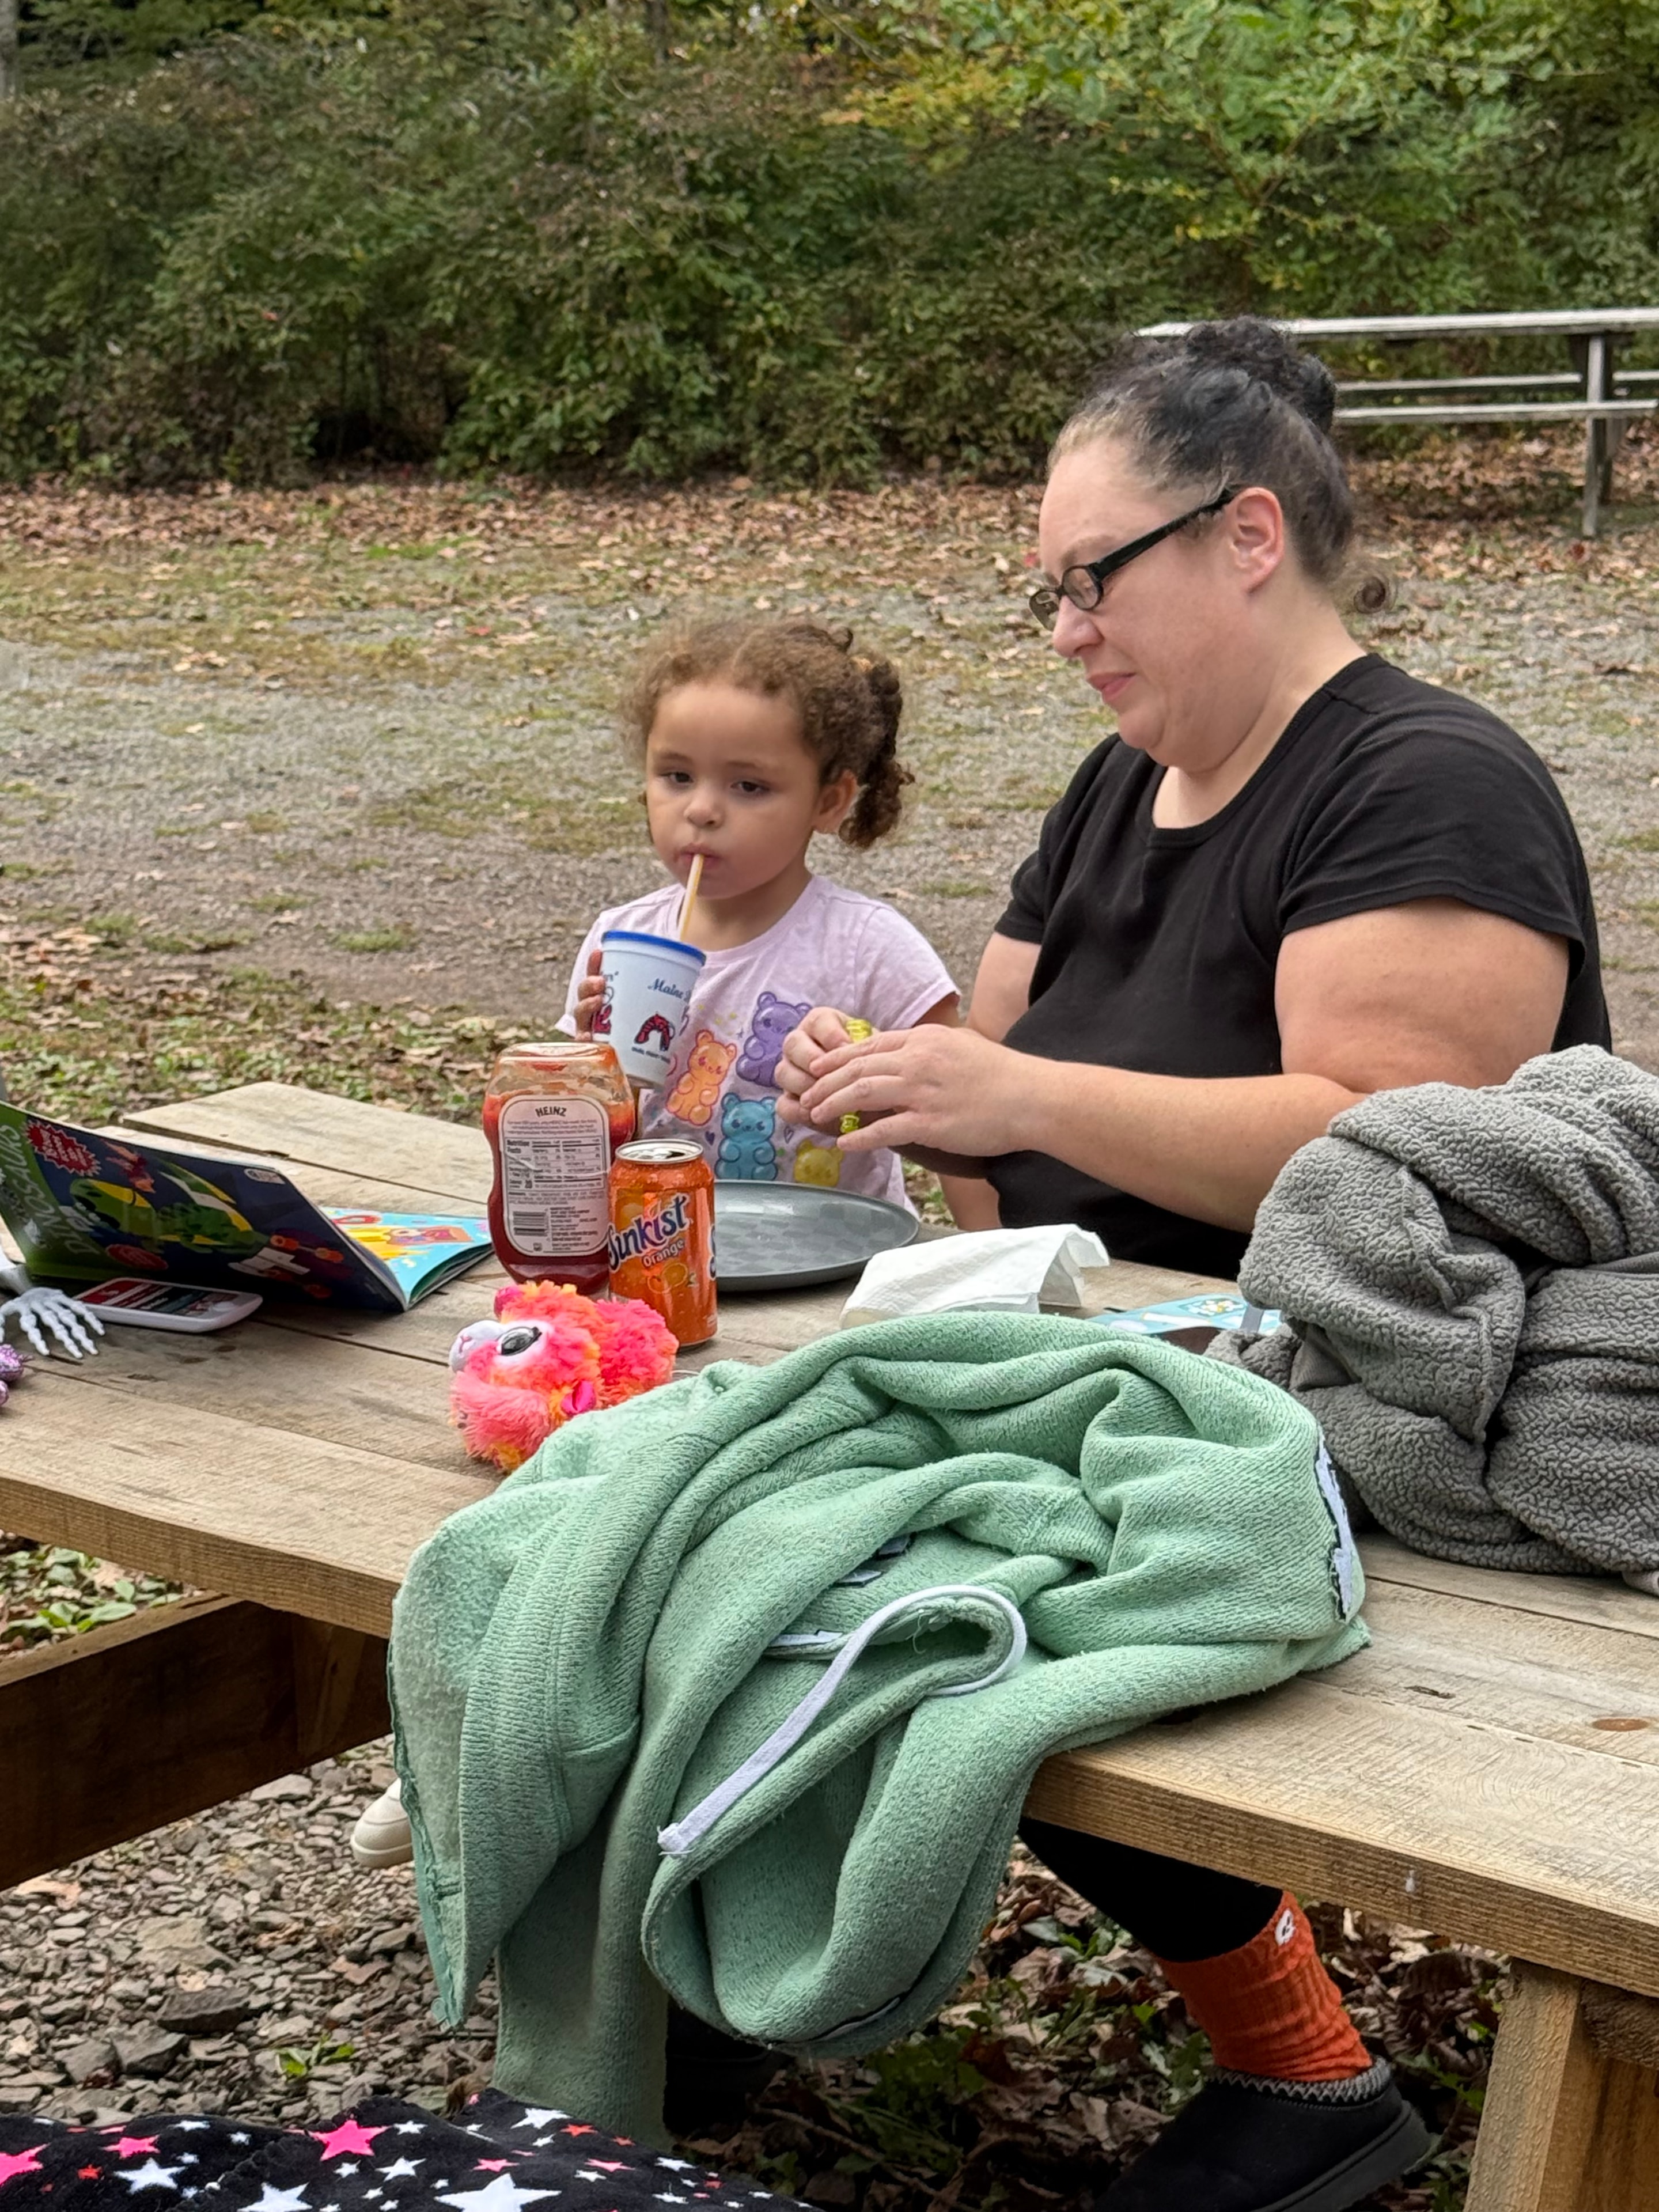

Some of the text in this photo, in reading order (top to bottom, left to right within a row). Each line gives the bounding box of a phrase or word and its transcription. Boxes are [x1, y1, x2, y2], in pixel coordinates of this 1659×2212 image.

[647, 978, 683, 999] Maine
[535, 1106, 567, 1117] HEINZ
[608, 1195, 687, 1270] Sunkist
[643, 1240, 684, 1267] Orange
